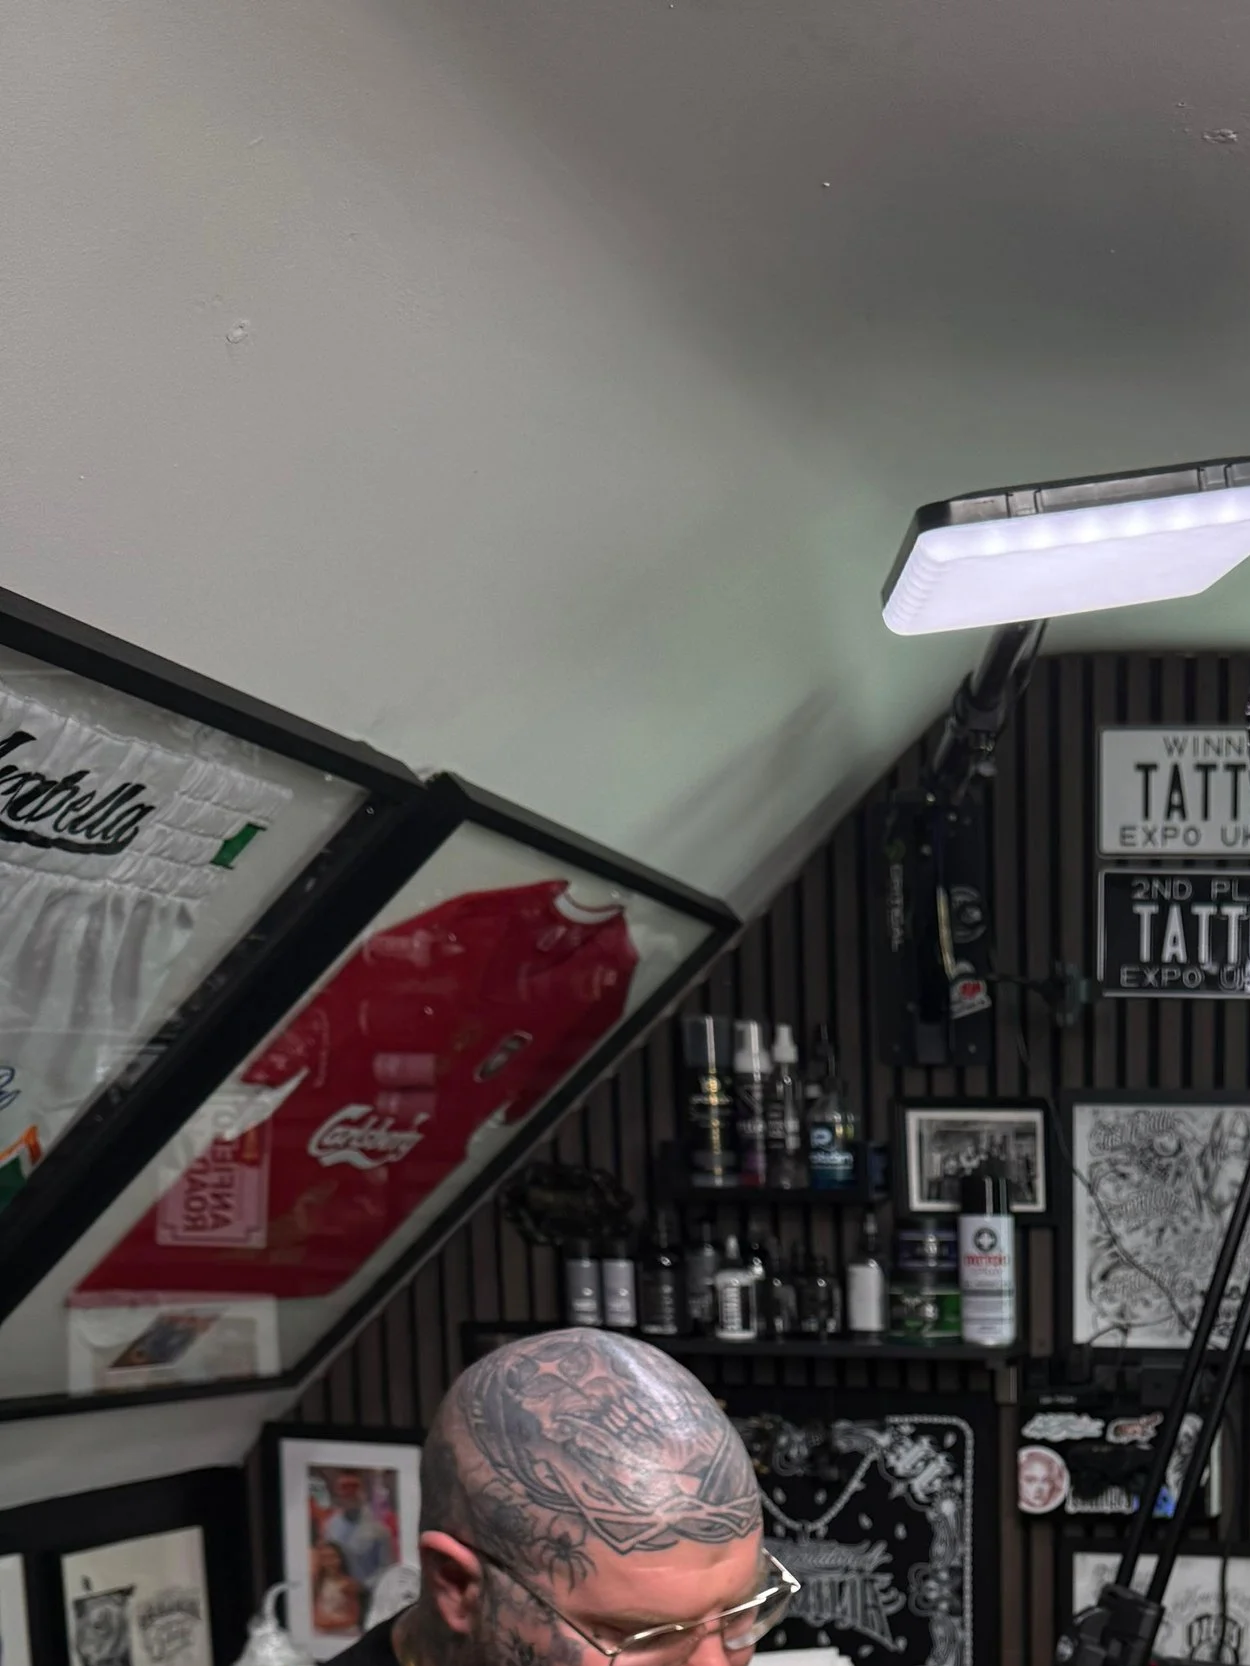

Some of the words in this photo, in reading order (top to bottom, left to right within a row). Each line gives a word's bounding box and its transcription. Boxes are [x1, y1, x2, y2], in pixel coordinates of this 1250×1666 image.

[1163, 735, 1249, 757] WINN
[1119, 825, 1201, 848] EXPO
[1131, 878, 1193, 901] 2ND
[1119, 965, 1202, 989] EXPO
